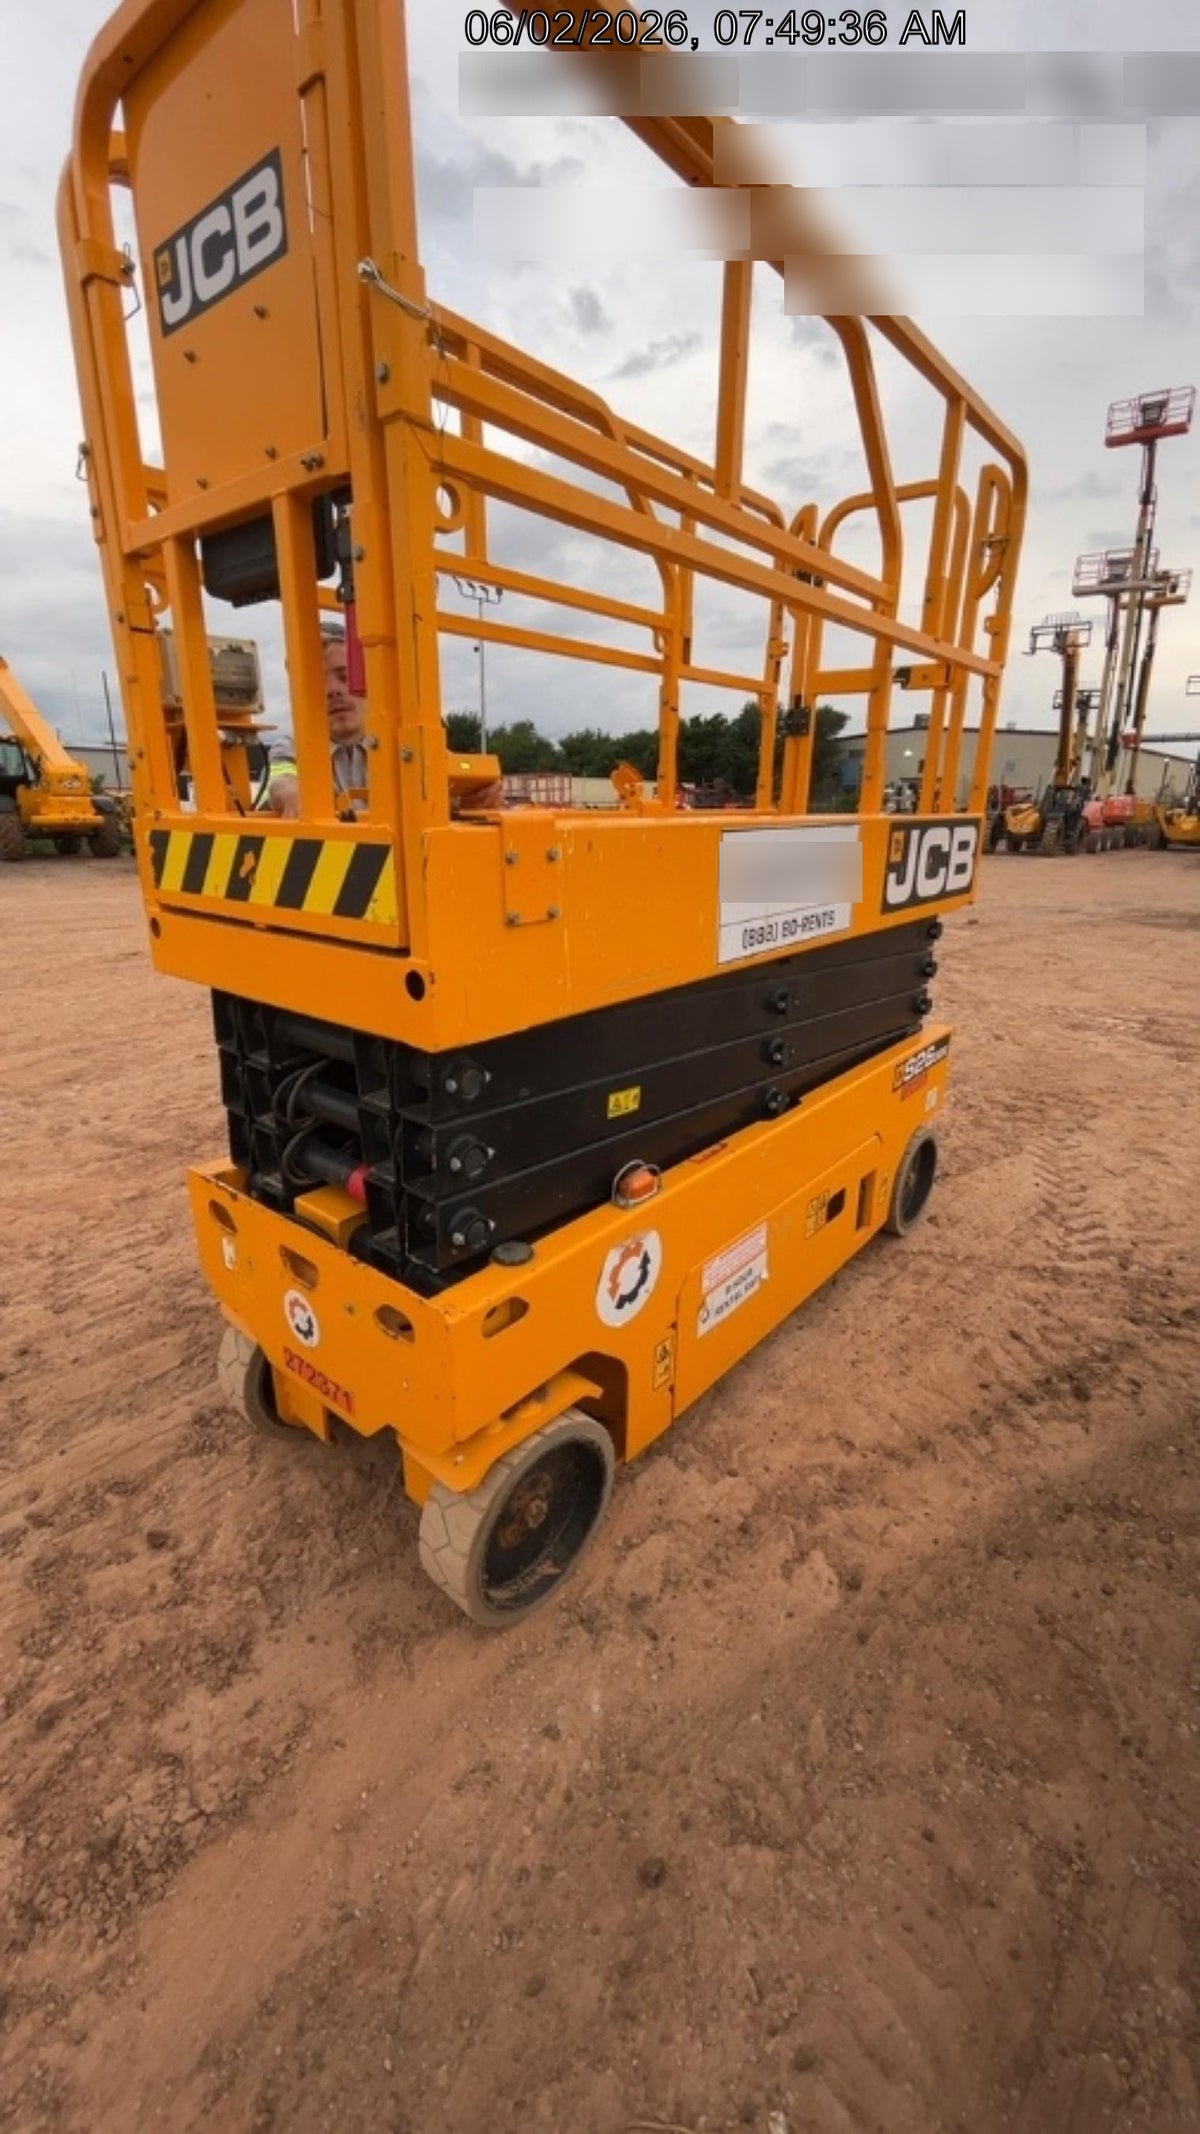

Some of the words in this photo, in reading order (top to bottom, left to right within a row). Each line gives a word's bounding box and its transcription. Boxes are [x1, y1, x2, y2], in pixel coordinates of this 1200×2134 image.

[161, 166, 283, 326] JCB
[886, 825, 978, 905] JCB
[283, 1346, 354, 1416] 272371
